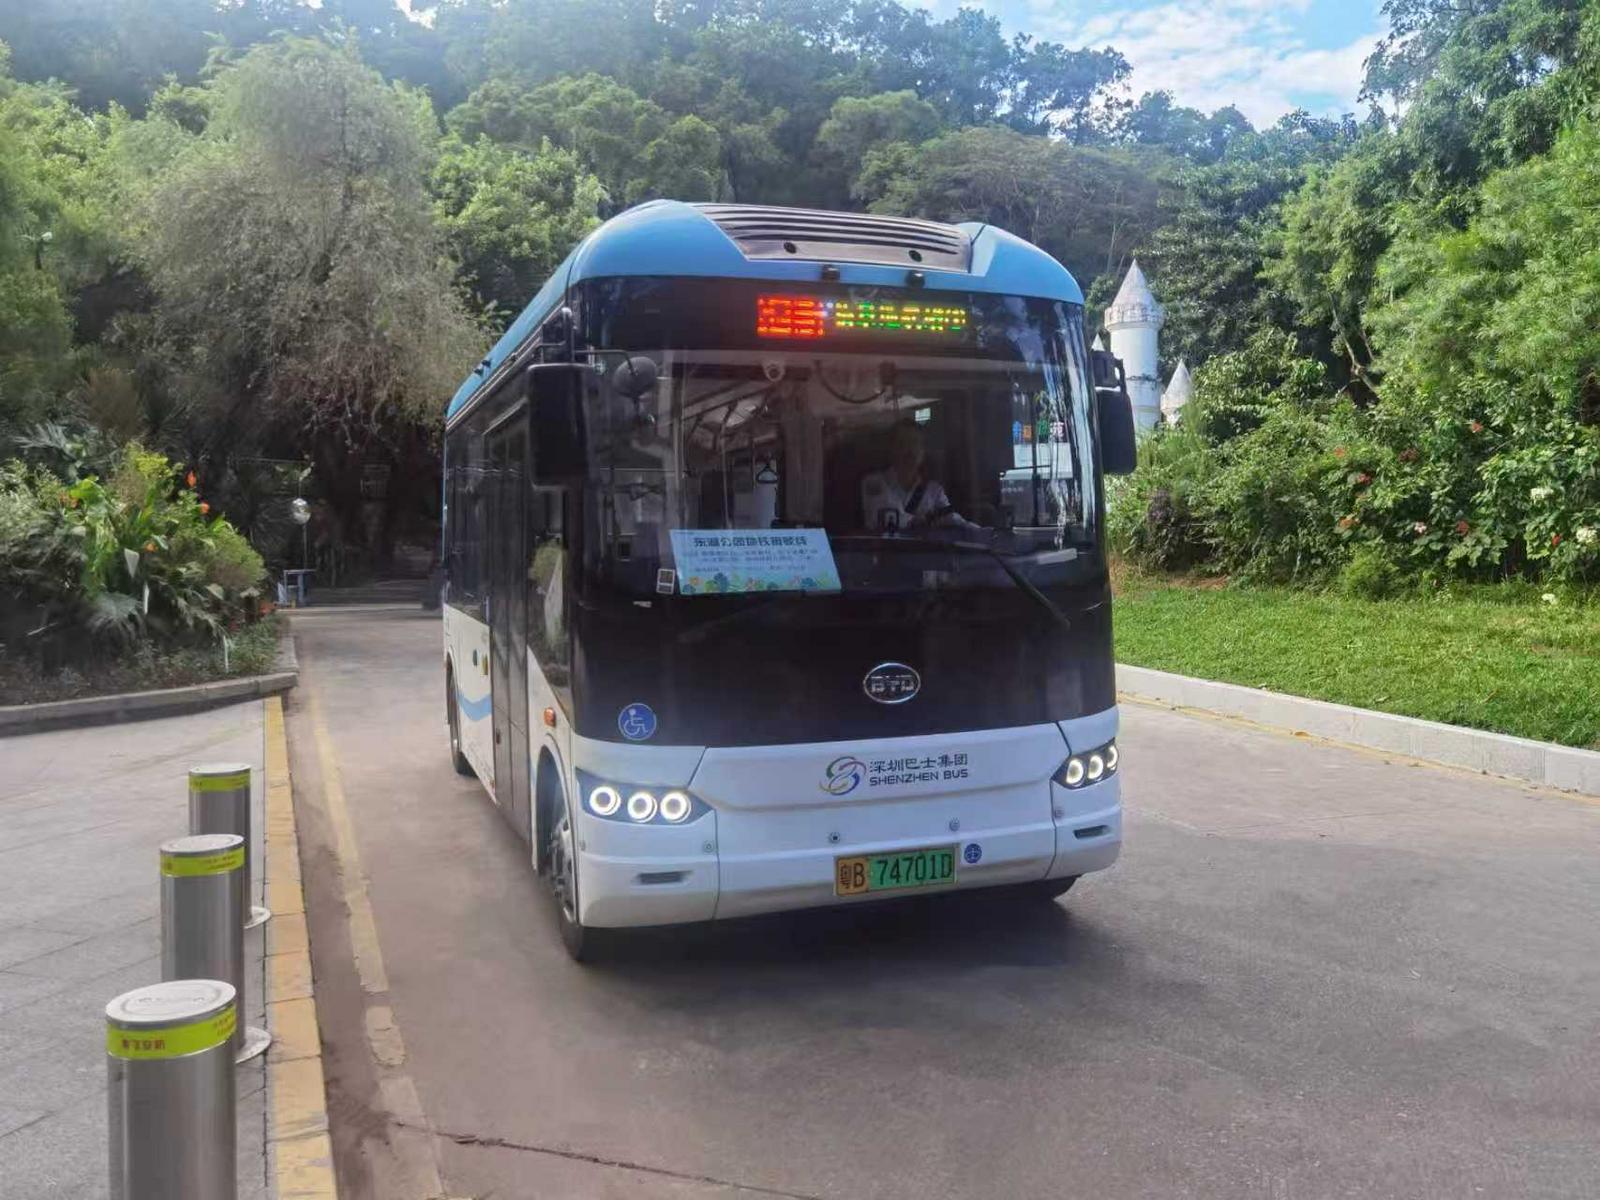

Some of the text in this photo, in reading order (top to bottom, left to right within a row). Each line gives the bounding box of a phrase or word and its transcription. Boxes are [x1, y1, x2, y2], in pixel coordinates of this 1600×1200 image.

[869, 753, 968, 774] 深圳巴士集团
[869, 768, 969, 787] SHENZHEN BUS
[876, 853, 952, 885] 74701D
